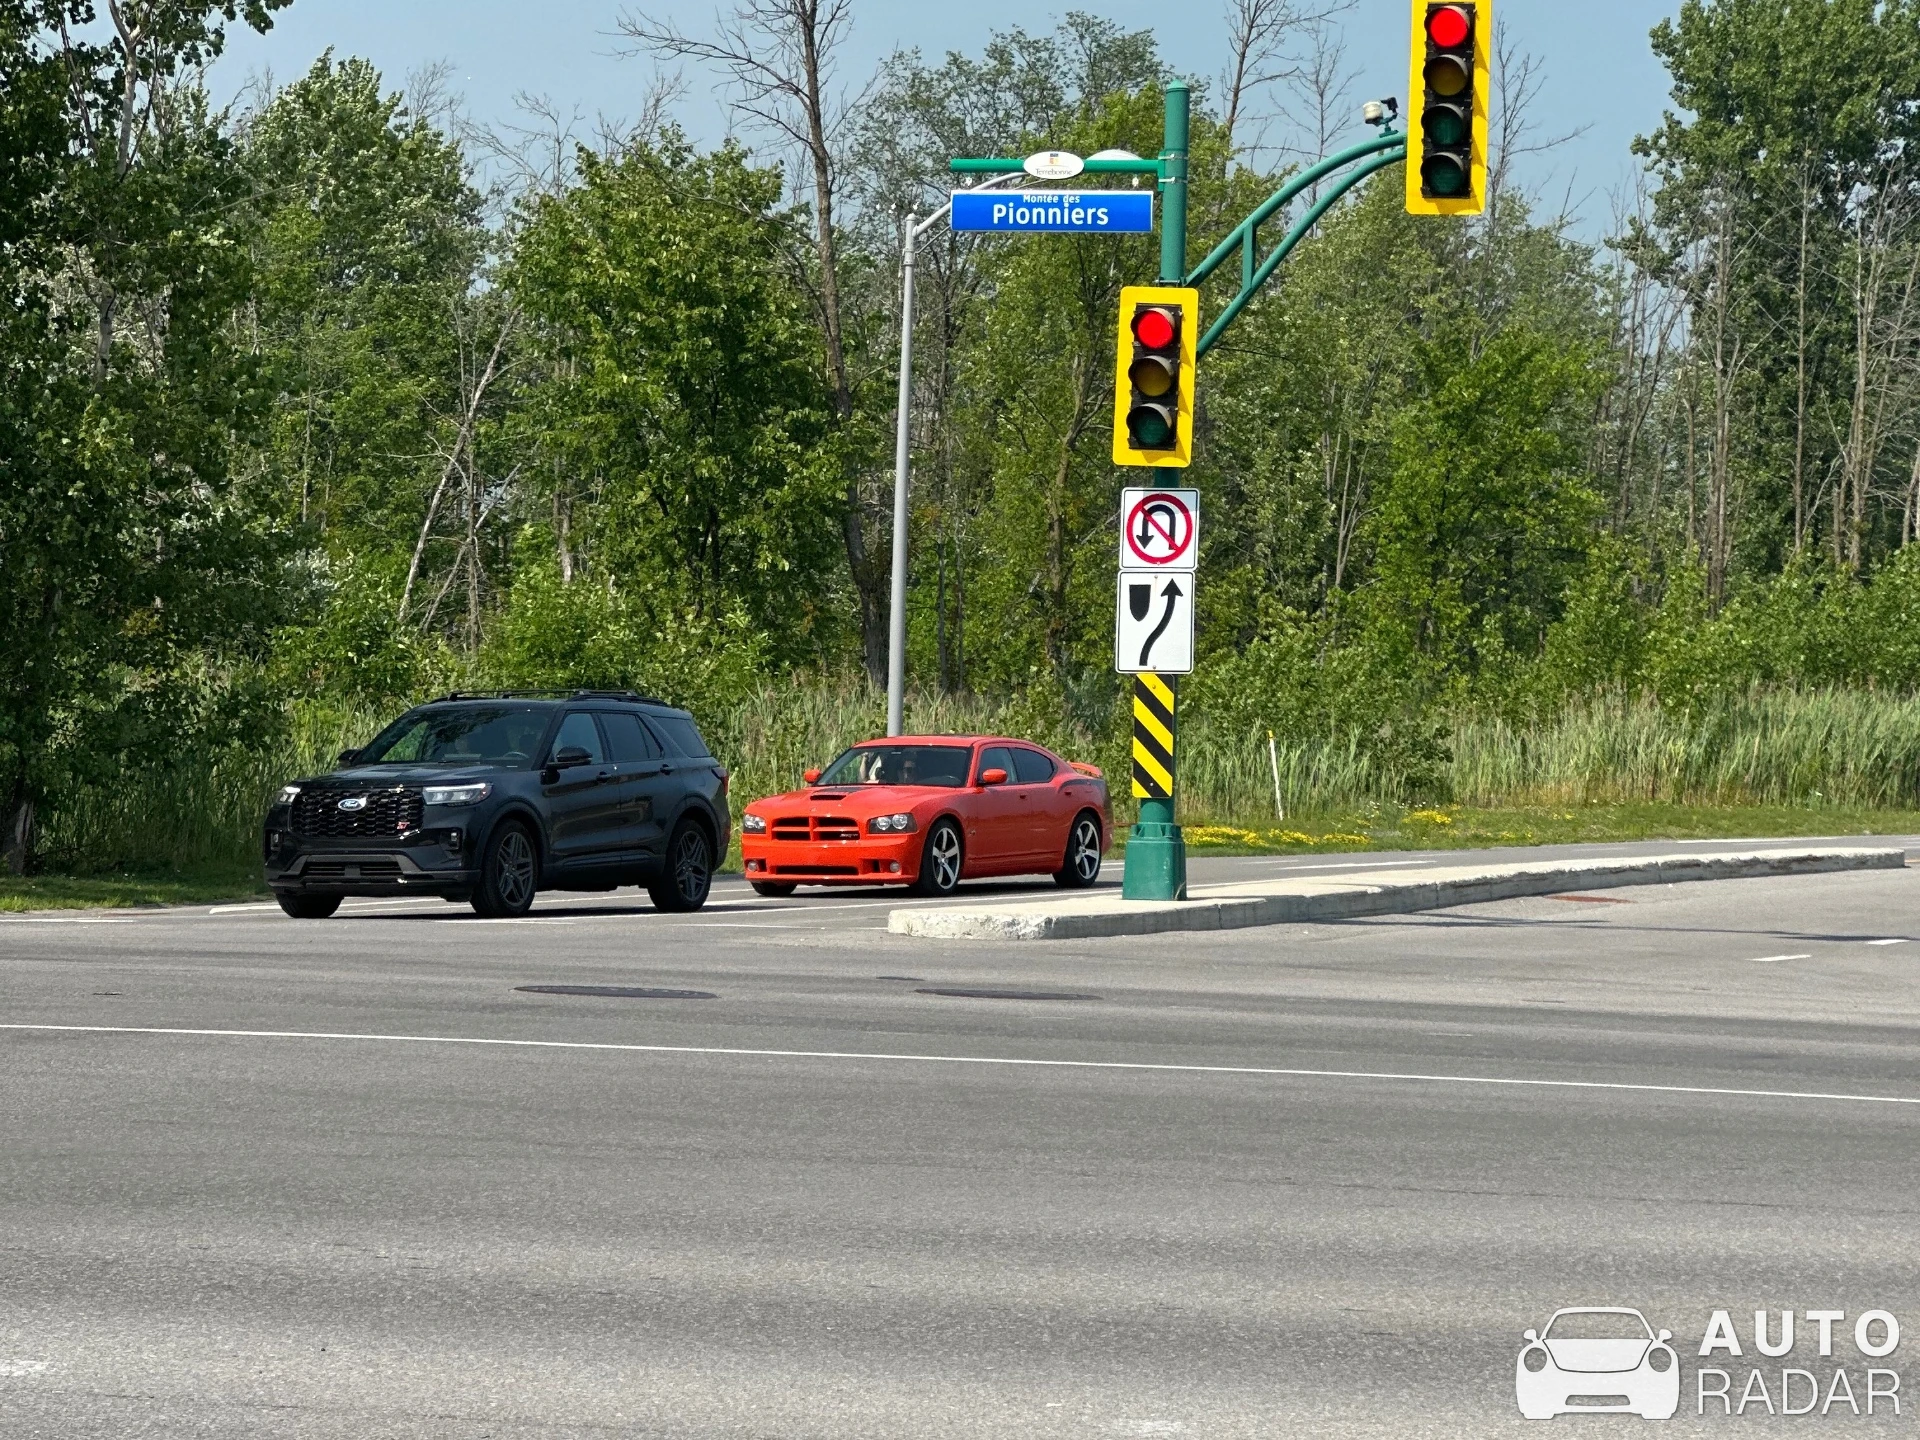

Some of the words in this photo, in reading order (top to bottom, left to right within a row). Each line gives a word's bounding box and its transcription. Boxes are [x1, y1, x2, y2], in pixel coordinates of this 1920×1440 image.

[1023, 194, 1059, 203] Montée
[1063, 194, 1080, 203] des
[993, 202, 1109, 225] Pionniers
